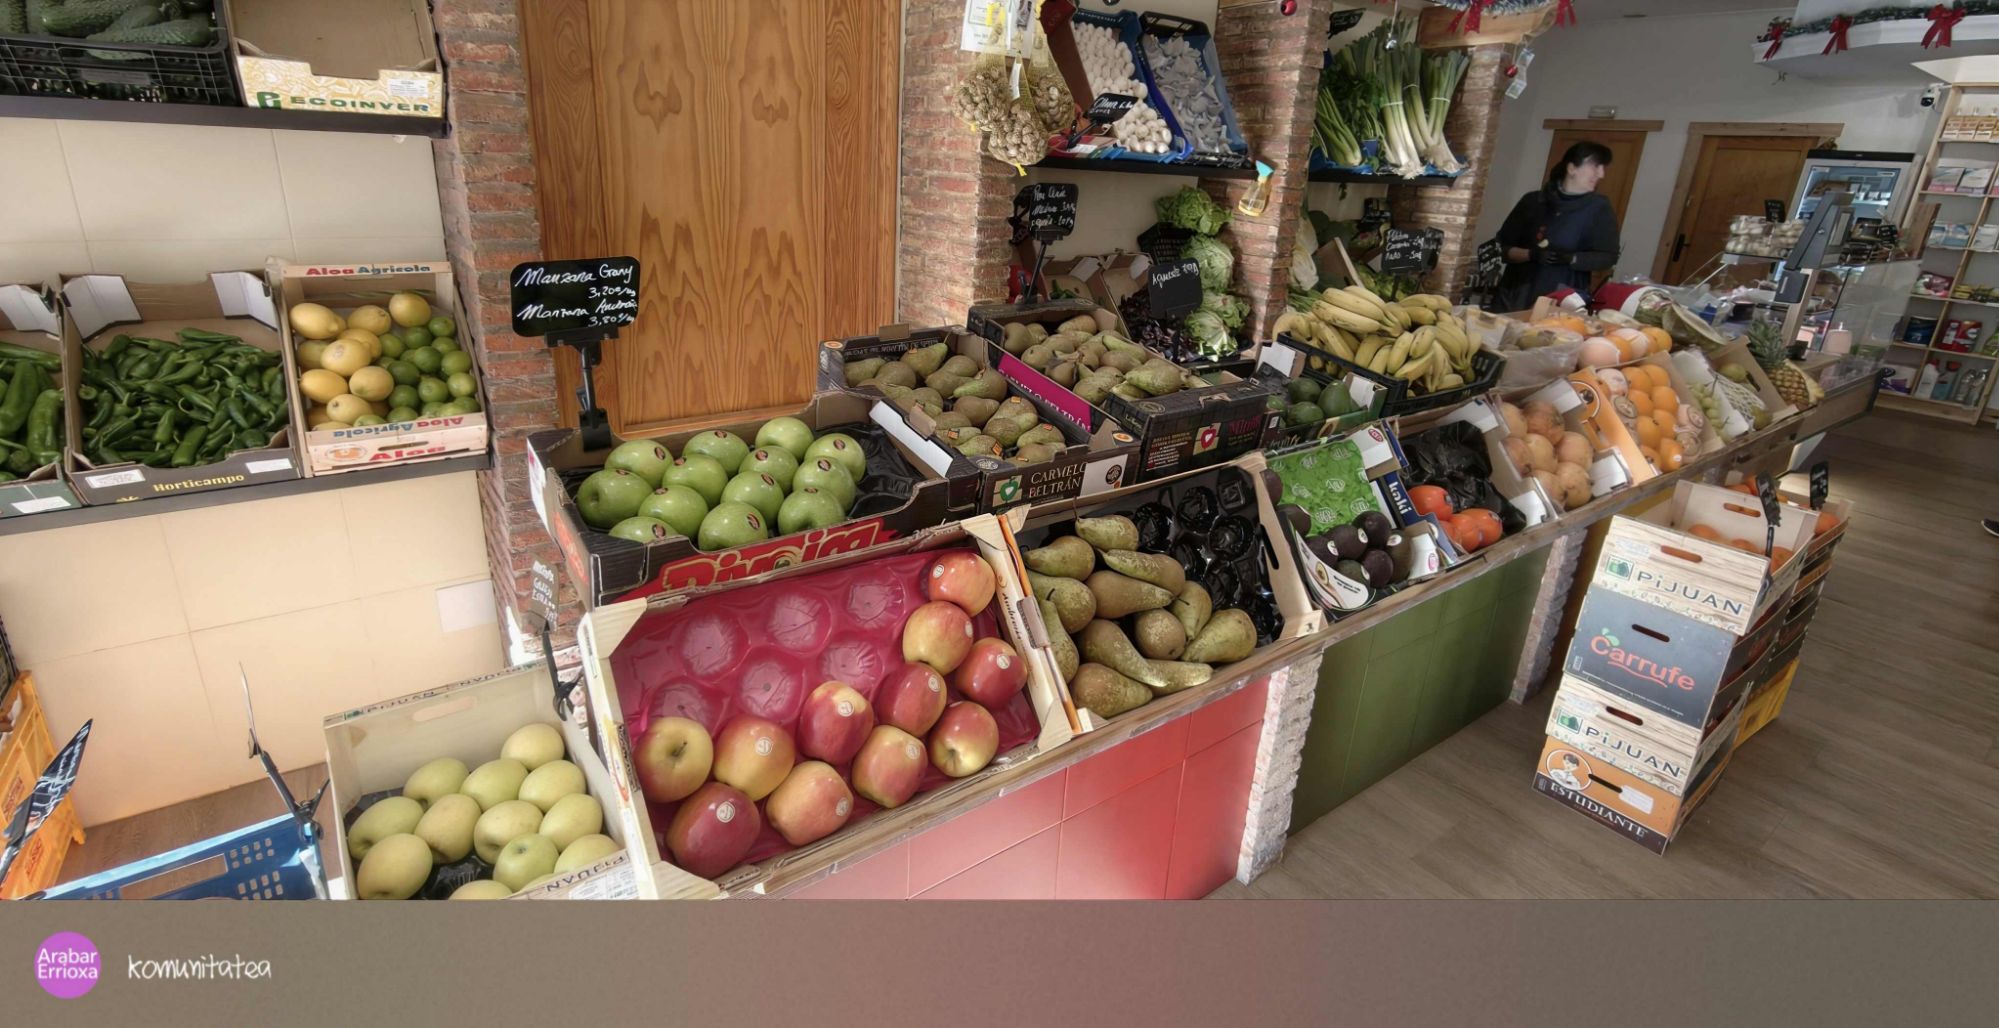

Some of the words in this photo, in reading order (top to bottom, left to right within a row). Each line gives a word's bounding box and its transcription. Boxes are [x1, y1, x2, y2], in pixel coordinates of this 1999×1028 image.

[290, 96, 429, 112] ECOINVER
[306, 267, 355, 276] Aloa
[357, 264, 431, 275] Agricola
[514, 267, 597, 288] Manzana
[516, 304, 590, 320] Manzana
[333, 422, 415, 439] Agricola
[416, 416, 465, 428] Aloa
[152, 474, 246, 492] Horticampo
[1031, 462, 1088, 484] CARMELO
[1029, 476, 1082, 499] BELTRÁN
[1388, 481, 1412, 515] kaki
[1590, 635, 1696, 692] Carrufe
[1550, 782, 1649, 838] ESTUDIANTE
